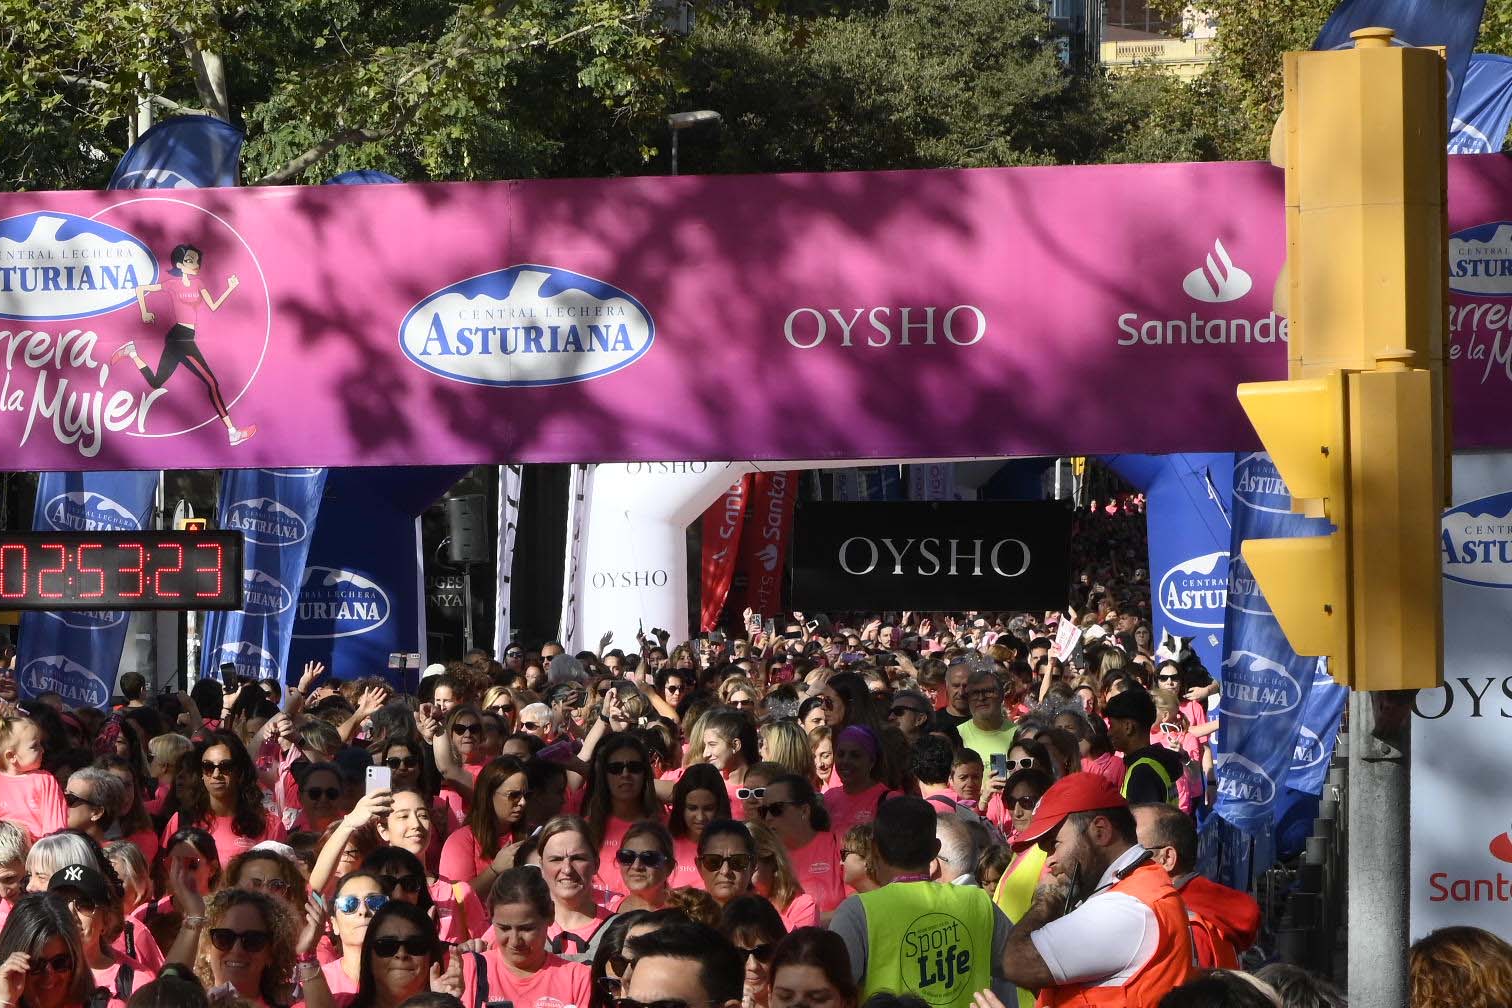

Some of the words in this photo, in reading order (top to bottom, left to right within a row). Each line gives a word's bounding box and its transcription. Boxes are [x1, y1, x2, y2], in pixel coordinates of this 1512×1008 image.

[419, 310, 634, 357] ASTURIANA
[458, 308, 537, 320] CENTRAL
[545, 305, 626, 318] LECHERA
[784, 304, 988, 349] OYSHO
[1467, 335, 1484, 360] la
[0, 372, 24, 412] la
[19, 363, 169, 458] Mujer
[0, 544, 222, 598] 02:53:23
[838, 536, 1031, 577] OYSHO
[592, 569, 668, 588] OYSHO
[905, 920, 961, 958] Sport
[917, 944, 971, 989] Life
